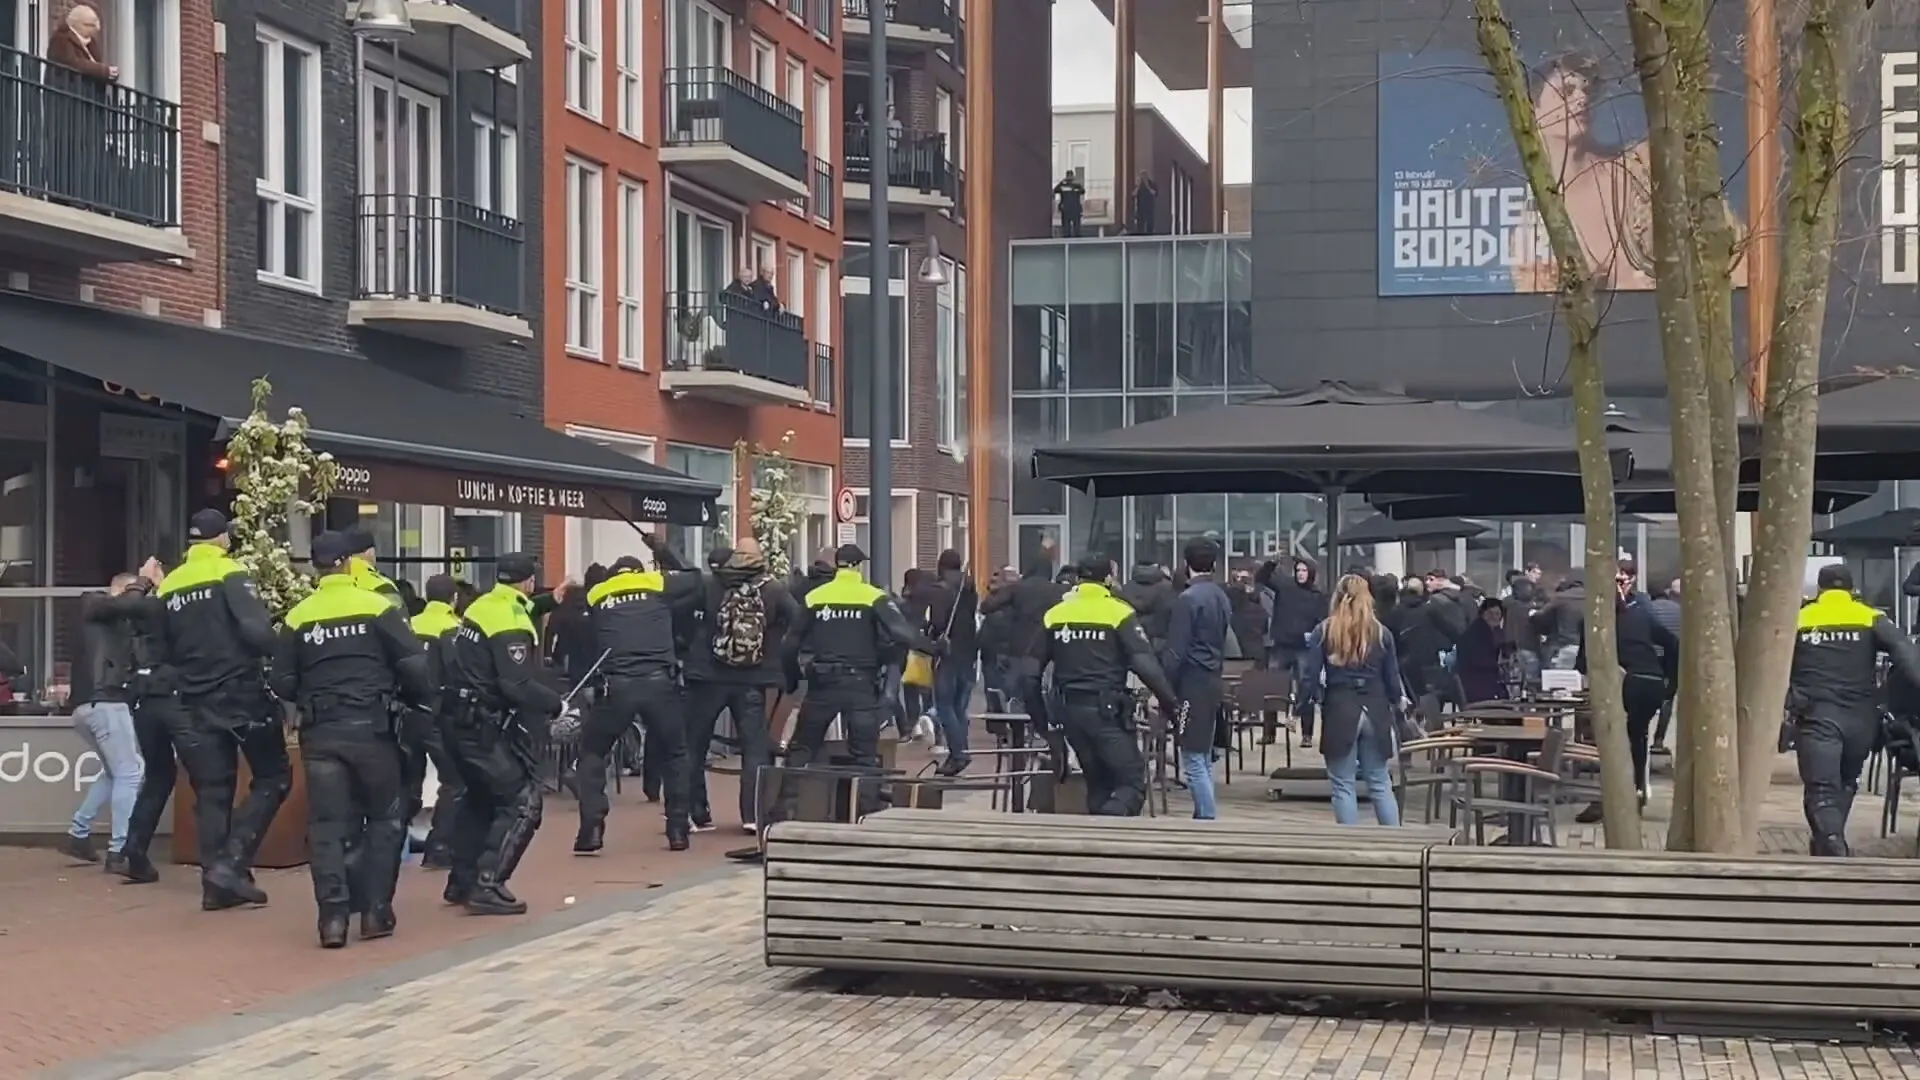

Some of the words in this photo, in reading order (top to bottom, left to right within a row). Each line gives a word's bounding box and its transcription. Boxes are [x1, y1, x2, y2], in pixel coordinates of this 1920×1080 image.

[1394, 187, 1525, 228] HAUTE
[457, 479, 495, 502] LUNCH
[507, 484, 545, 506] KOFFIE
[548, 489, 556, 506] &
[601, 592, 648, 610] POLITIE
[815, 605, 862, 621] POLITIE
[303, 622, 367, 645] POLITIE
[1054, 624, 1106, 644] POLITIE
[1801, 628, 1861, 645] POLITIE
